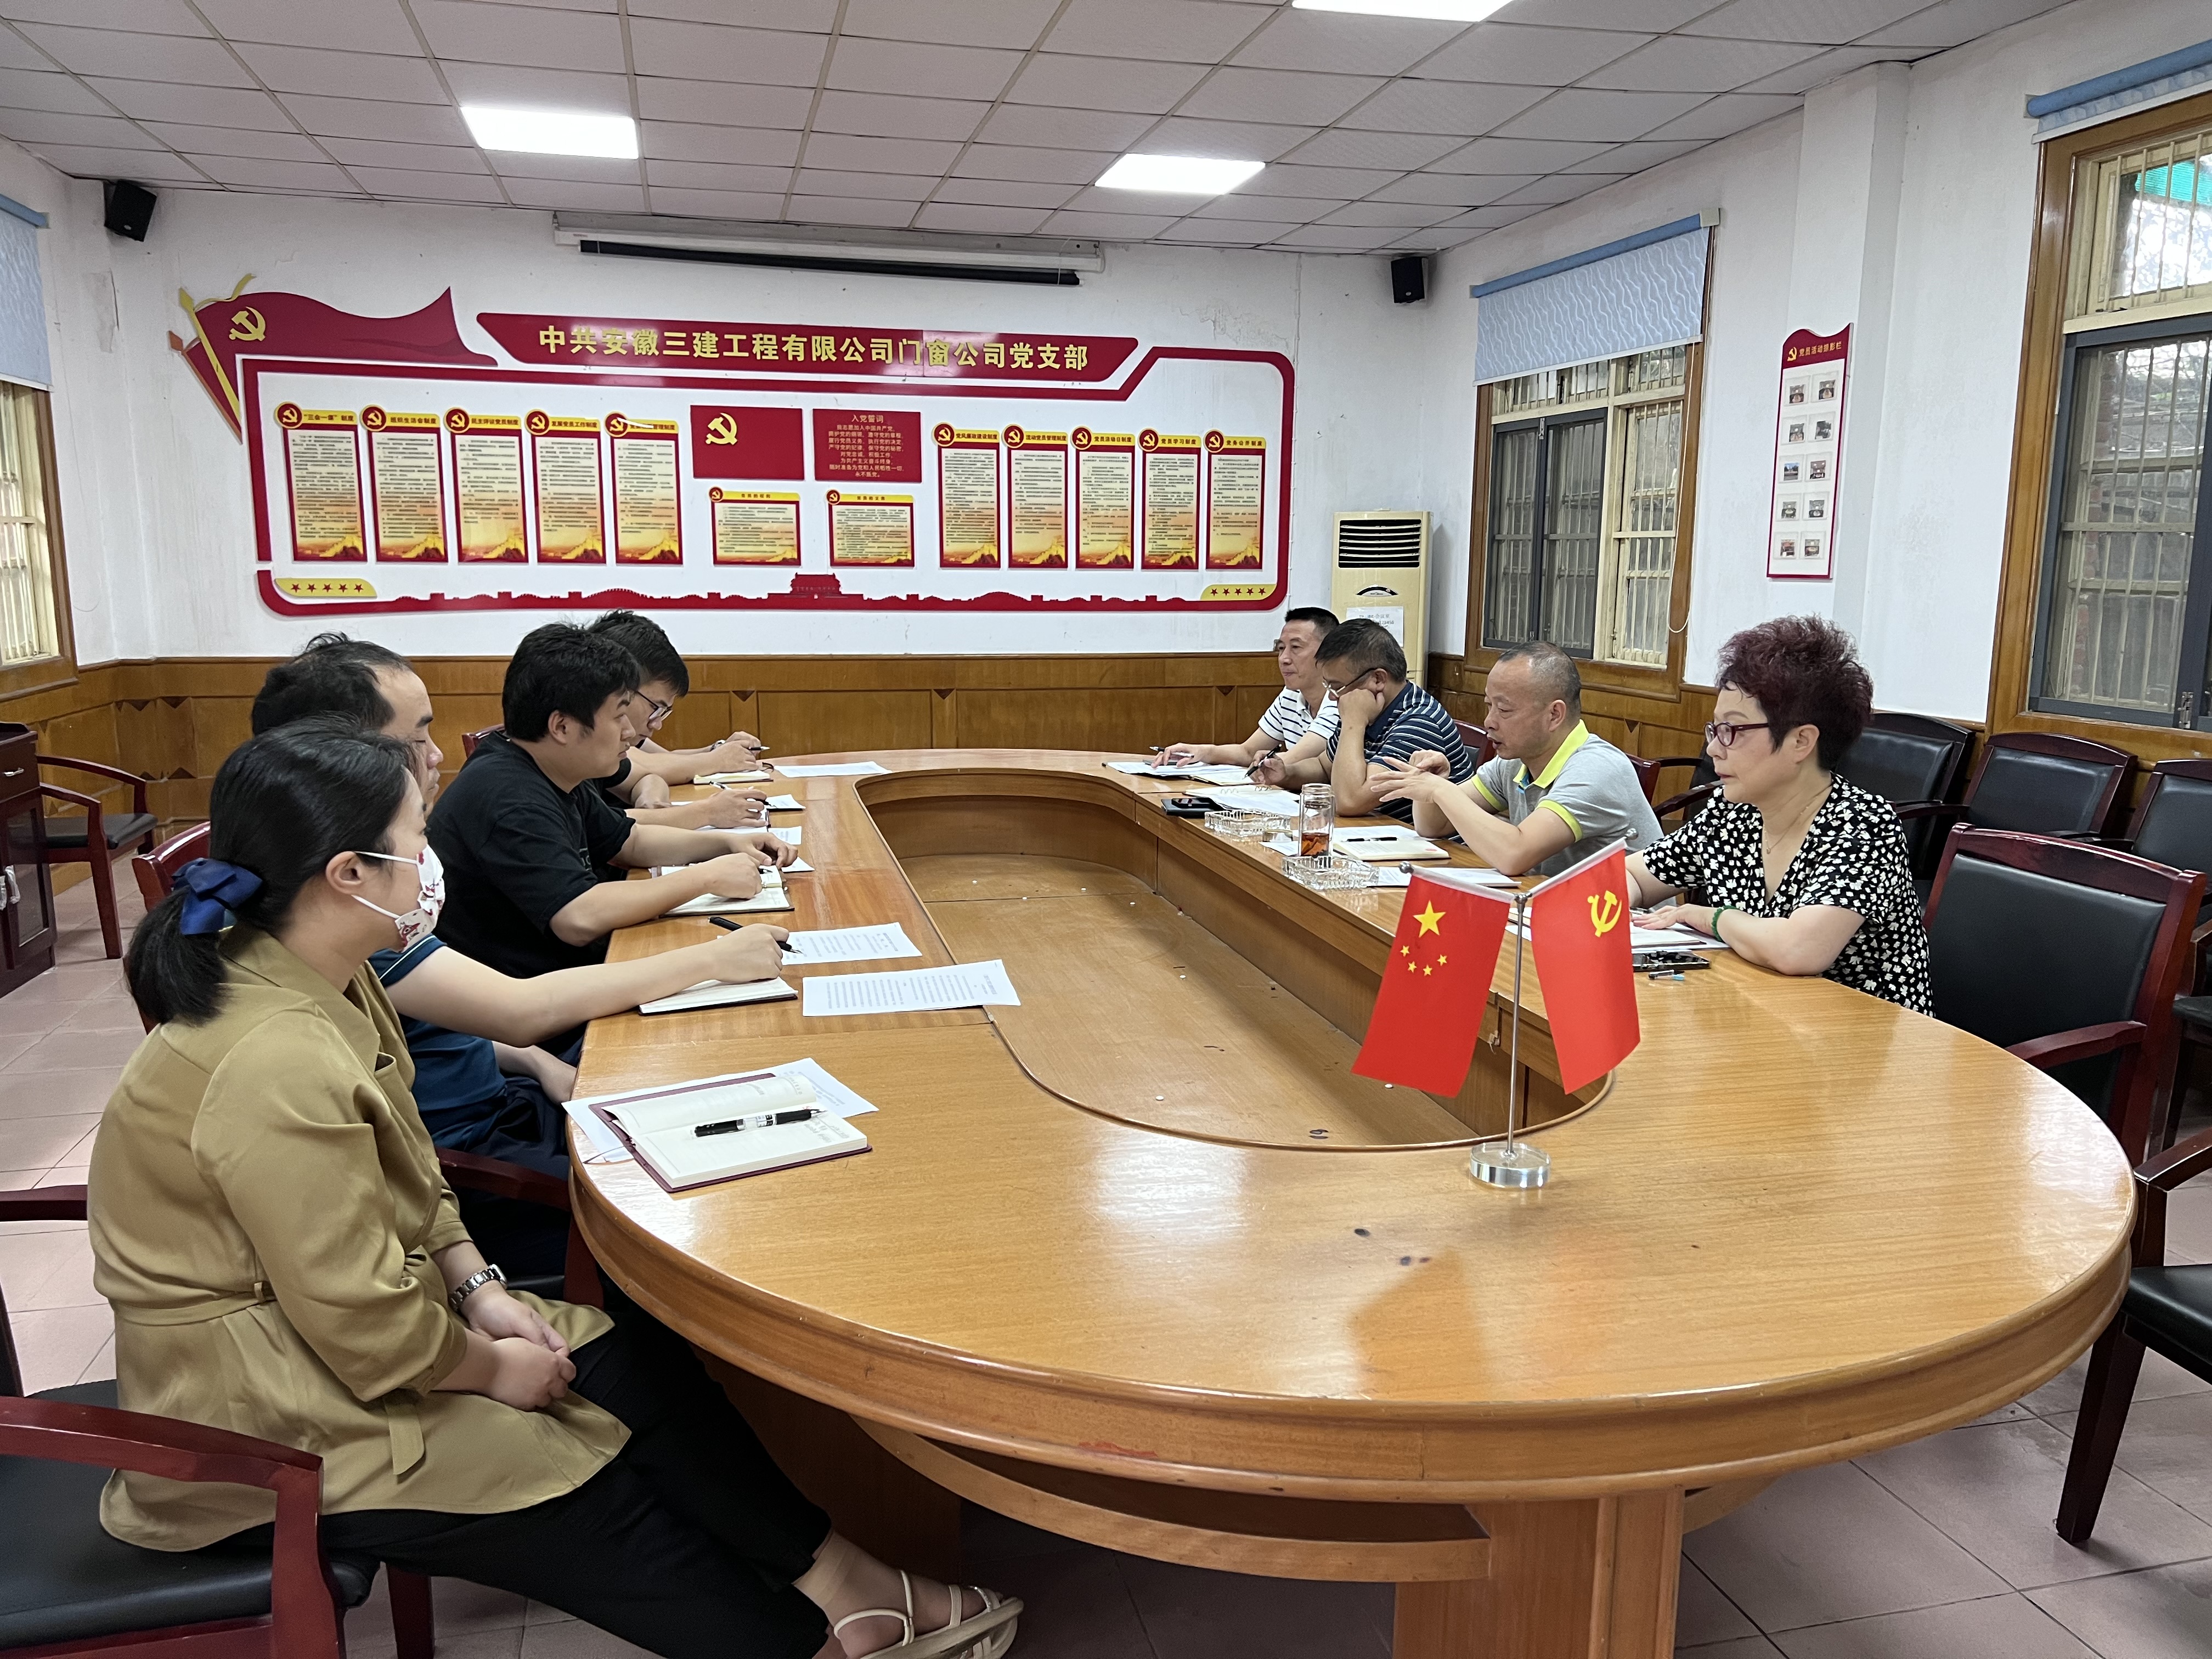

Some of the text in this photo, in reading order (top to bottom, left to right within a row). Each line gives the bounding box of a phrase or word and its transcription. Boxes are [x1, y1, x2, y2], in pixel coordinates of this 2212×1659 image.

[538, 325, 1089, 371] 中共安徽三建工程有限公司门窗公司党支部
[851, 414, 884, 424] 入党誓词
